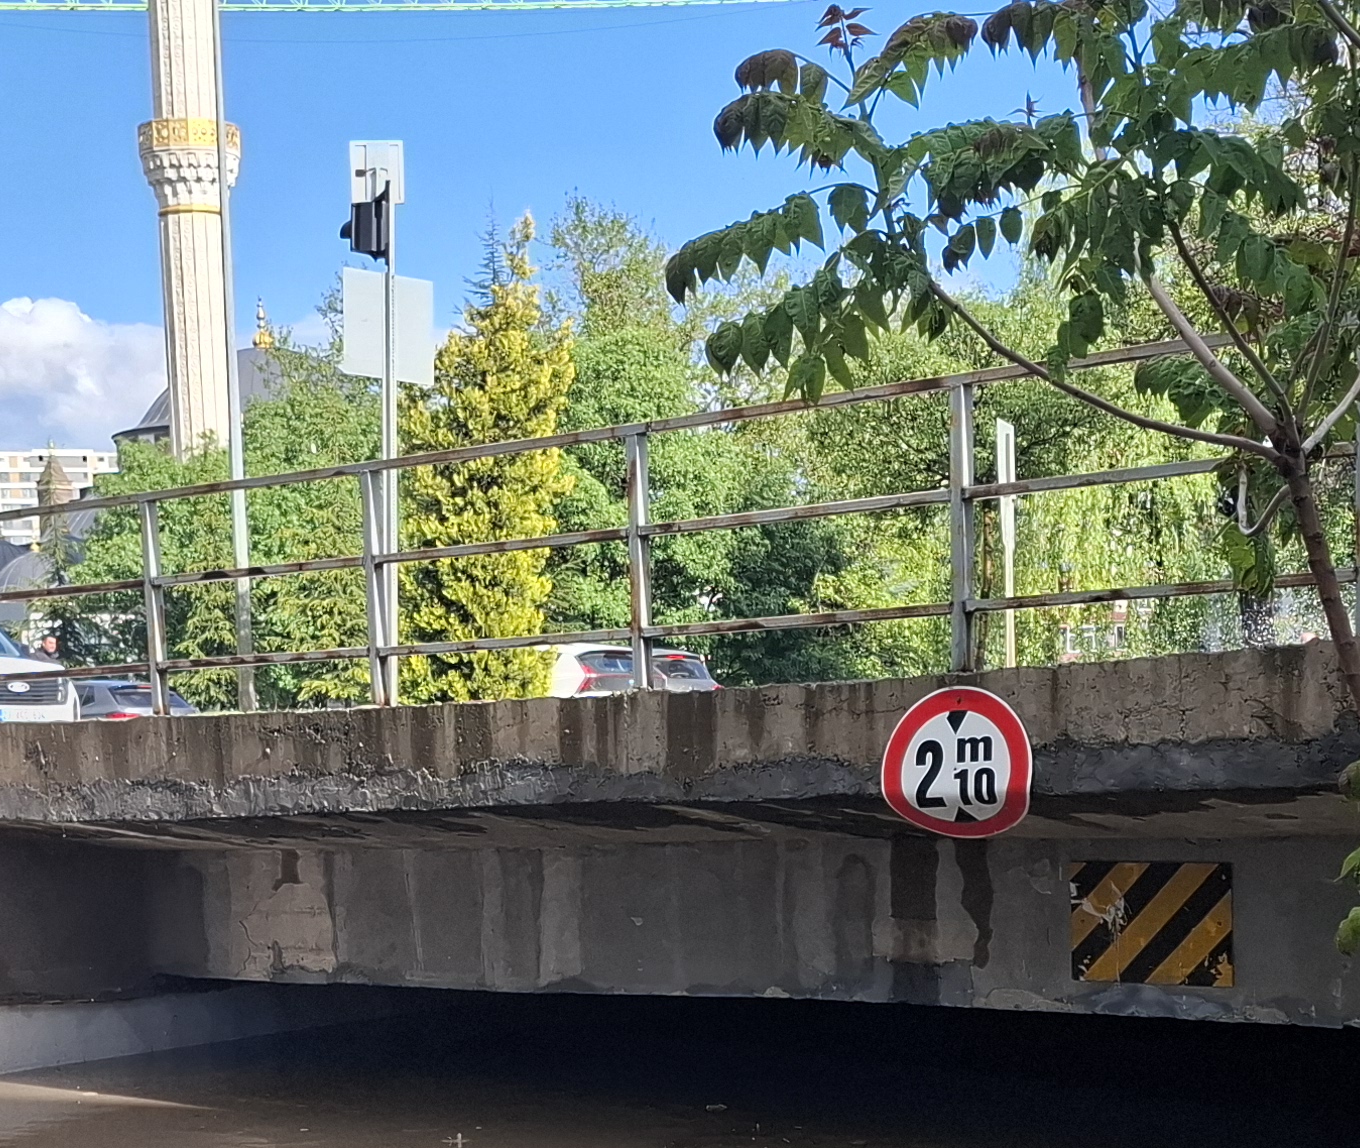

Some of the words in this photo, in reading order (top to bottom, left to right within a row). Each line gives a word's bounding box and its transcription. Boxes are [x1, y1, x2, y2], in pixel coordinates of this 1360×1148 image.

[915, 740, 948, 809] 2
[955, 735, 993, 763] m
[953, 767, 998, 806] 10
